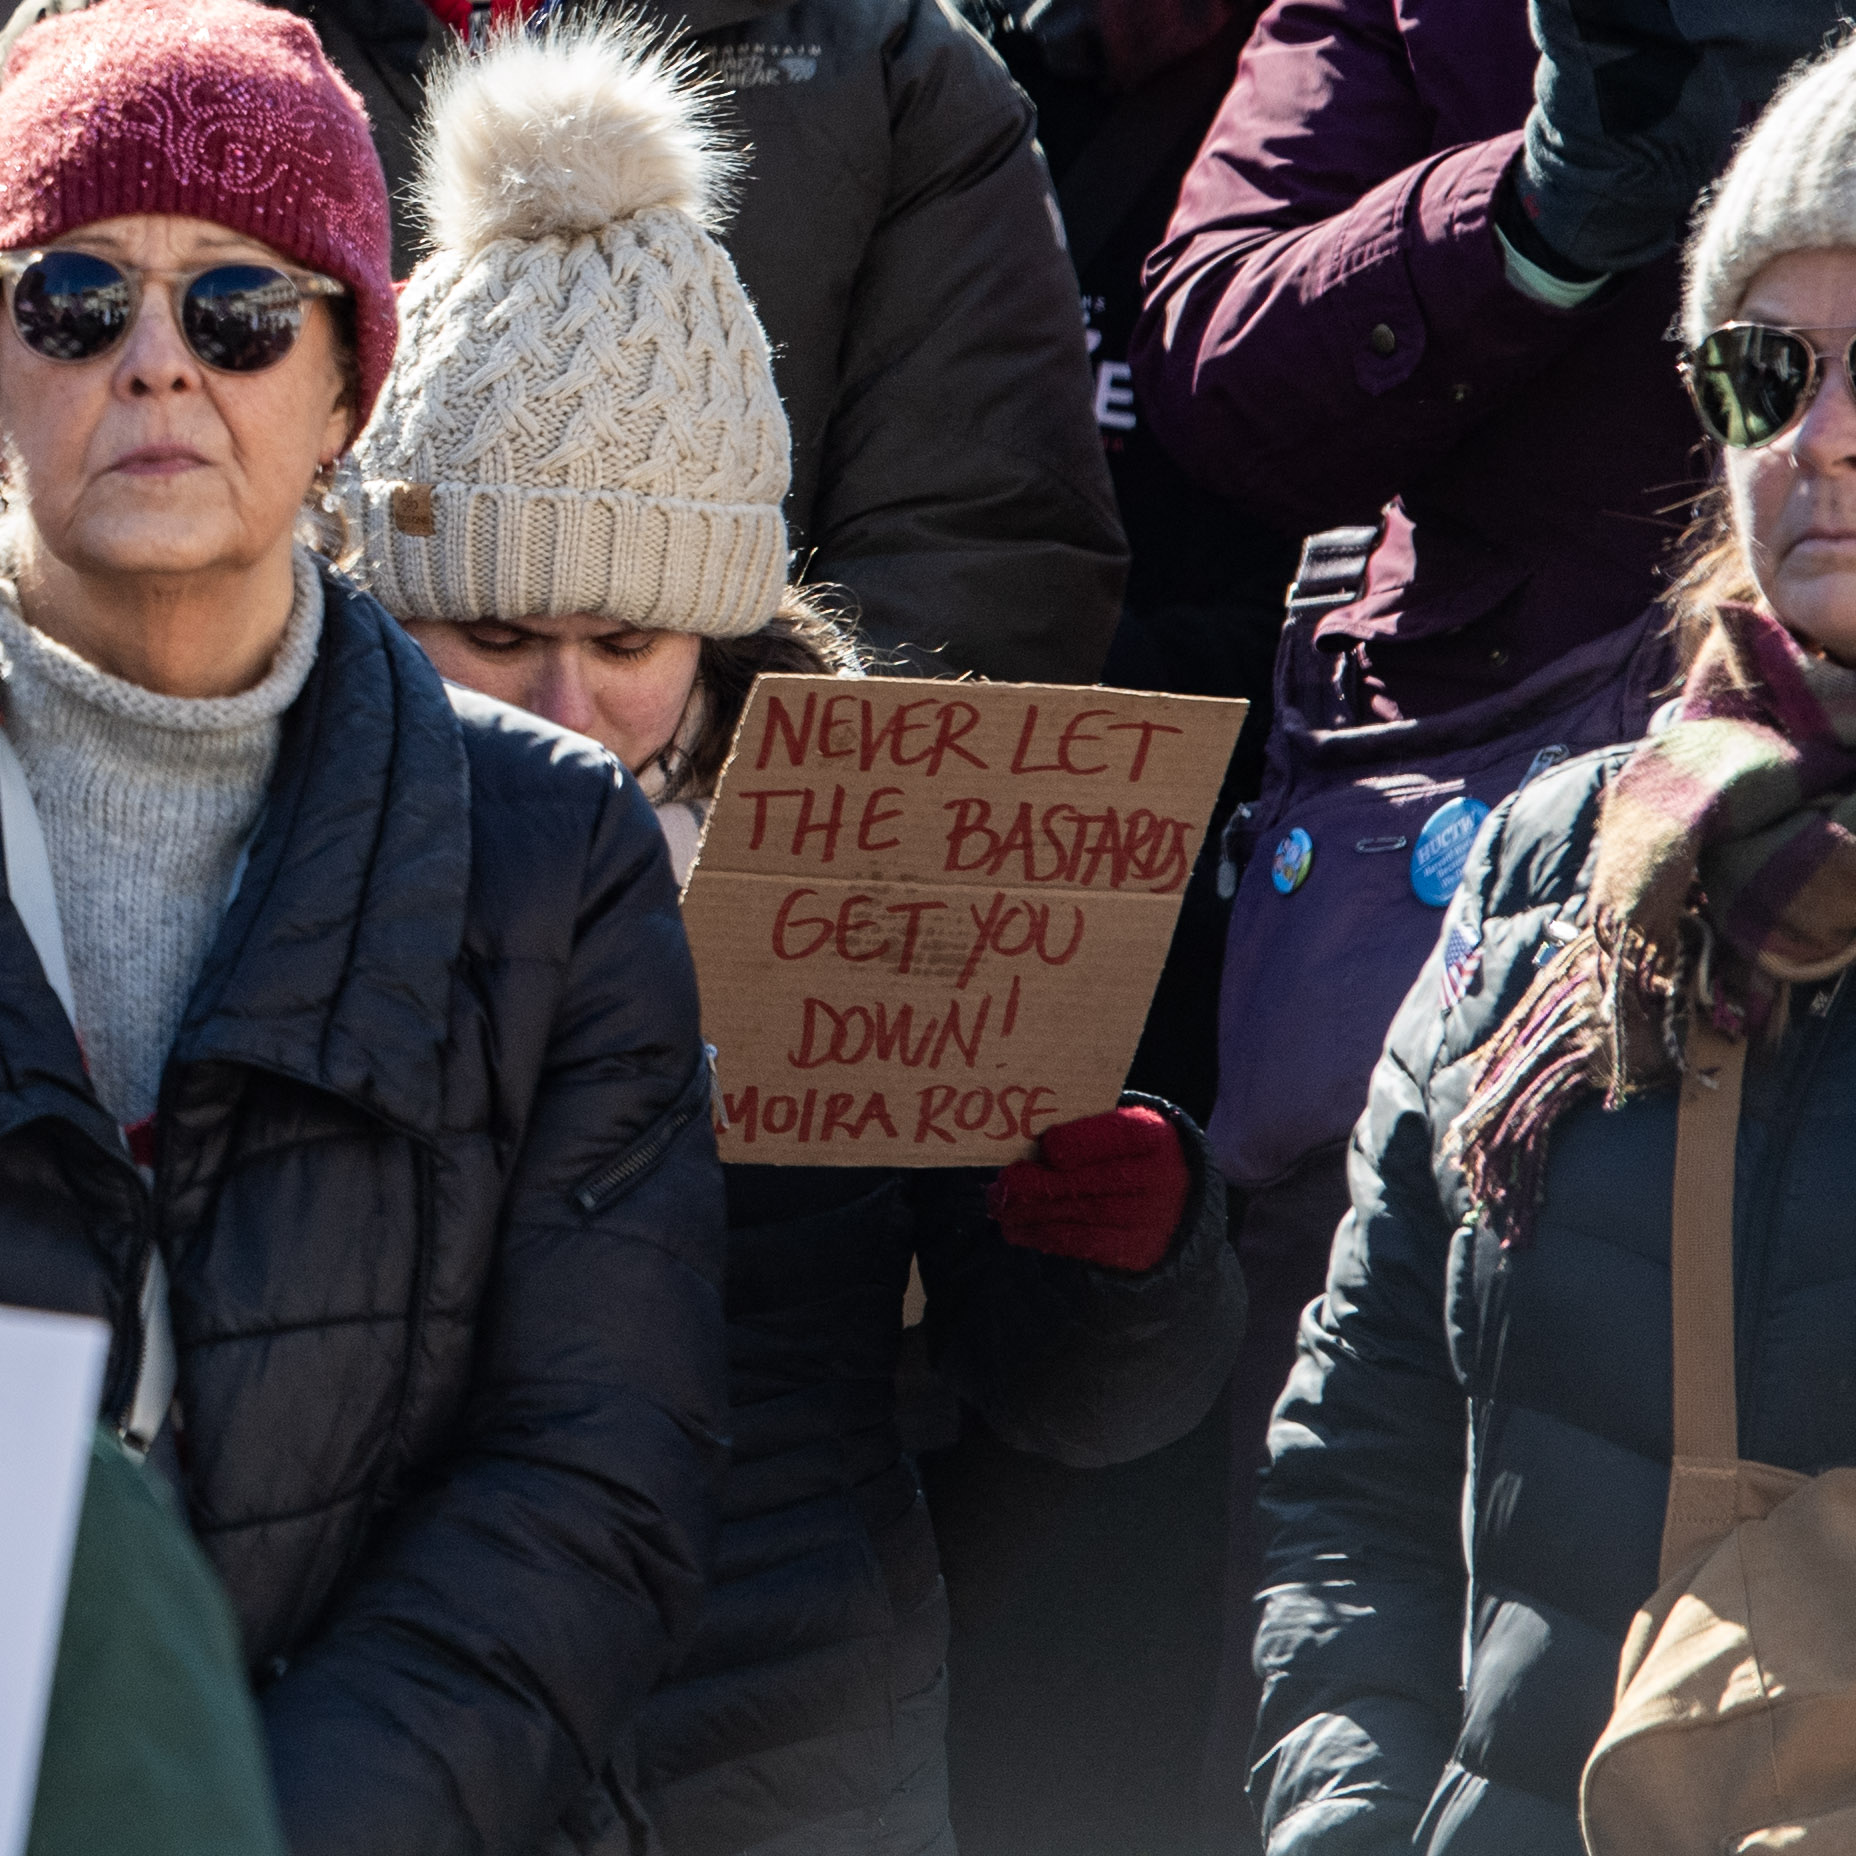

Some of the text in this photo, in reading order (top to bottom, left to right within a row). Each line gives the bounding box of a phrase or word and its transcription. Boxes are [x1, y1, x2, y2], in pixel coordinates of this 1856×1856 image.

[756, 693, 1185, 782] NEVER LET
[739, 784, 1196, 893] THE BASTARDS
[770, 888, 1086, 991] GET YOU
[788, 975, 1021, 1070] DOWN!
[714, 1084, 1058, 1144] MOIRA ROSE
